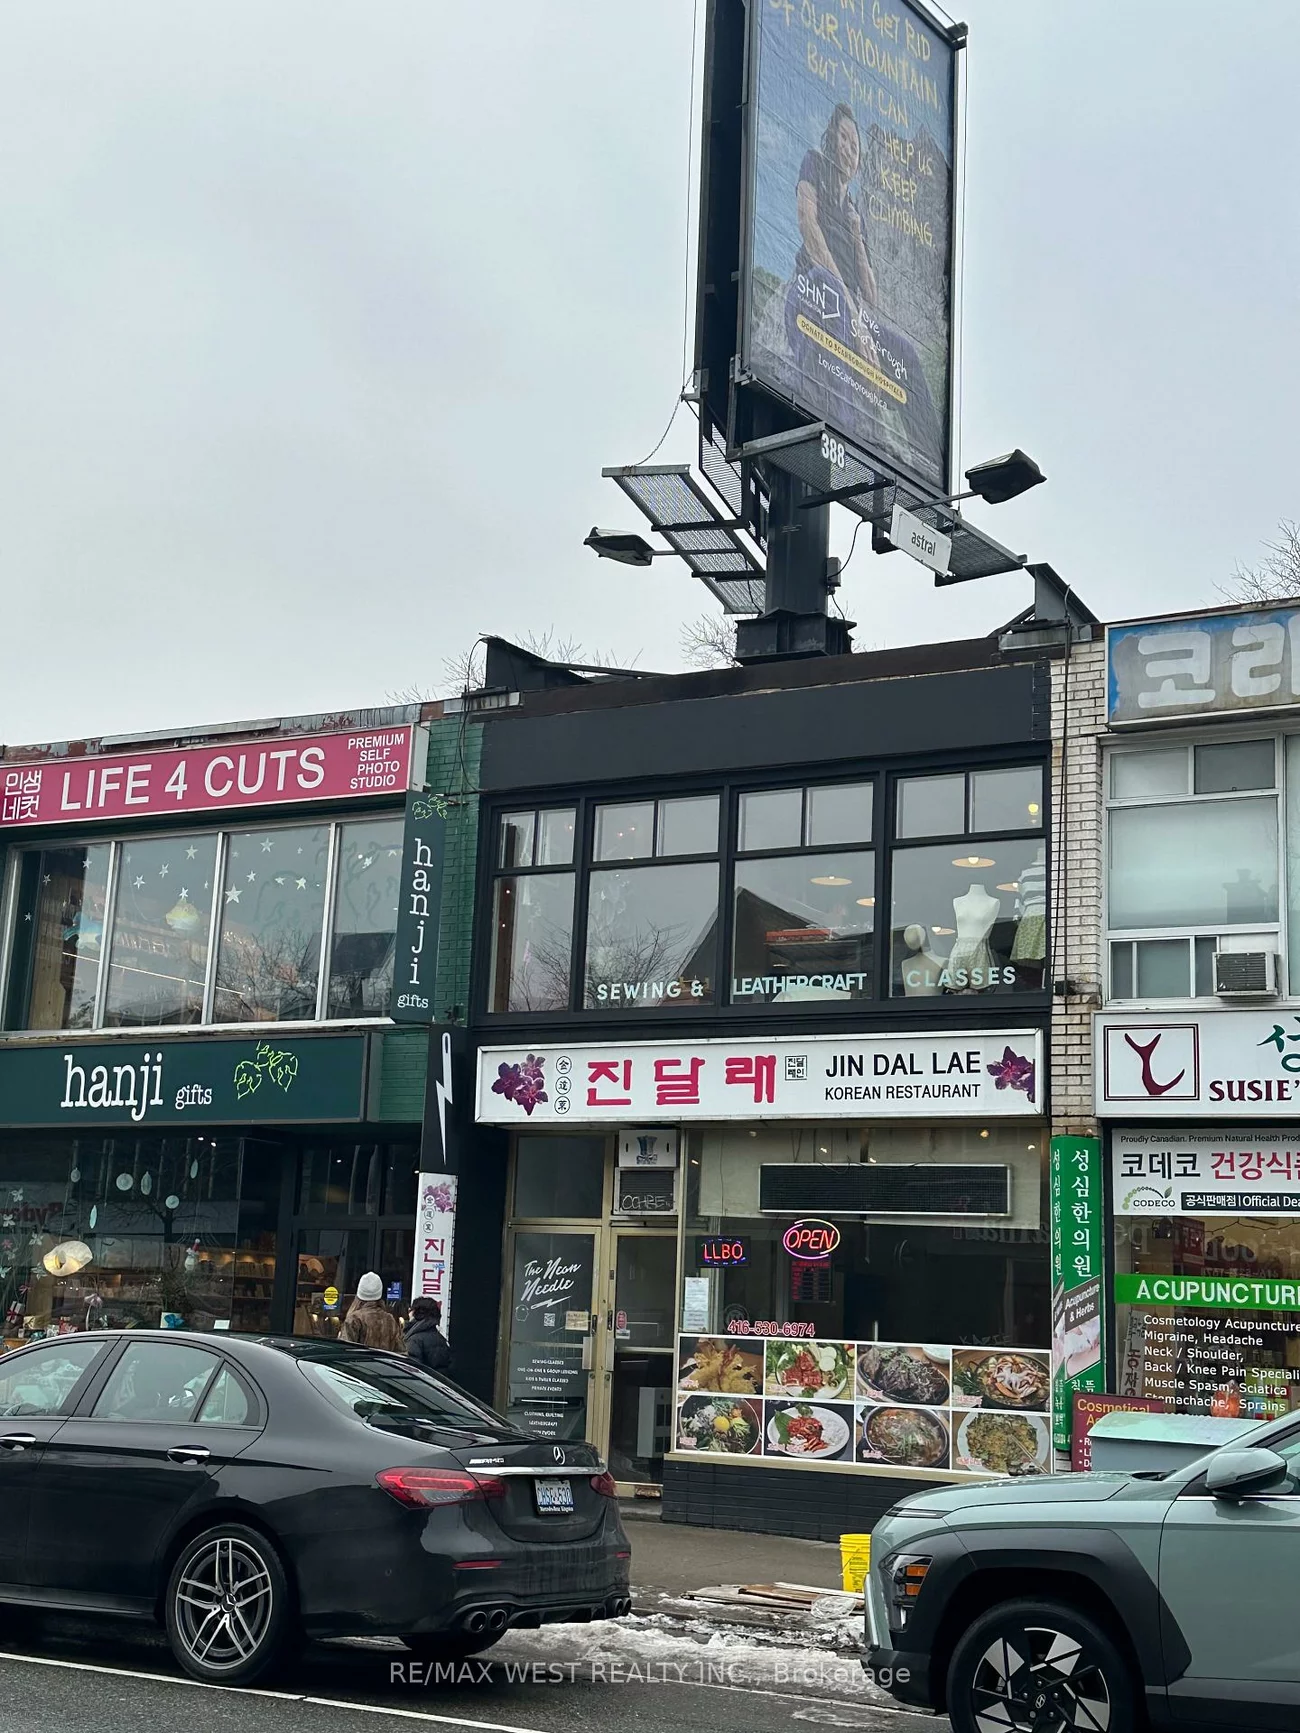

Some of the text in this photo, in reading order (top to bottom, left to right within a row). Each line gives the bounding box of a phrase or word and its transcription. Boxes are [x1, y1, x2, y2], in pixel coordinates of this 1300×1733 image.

[800, 2, 843, 49] OUR
[872, 2, 900, 44] GET
[905, 18, 931, 61] RID
[807, 42, 839, 87] BUT
[878, 87, 909, 129] CAN
[883, 126, 933, 176] HELP US
[880, 163, 917, 208] KEEP
[797, 274, 826, 309] SHN
[821, 433, 845, 468] 388
[911, 531, 937, 557] astral
[348, 733, 404, 750] PREMIUM
[357, 760, 400, 776] PHOTO
[359, 748, 391, 762] SELF
[5, 769, 42, 796] 인생
[61, 746, 326, 811] LIFE 4 CUTS
[350, 774, 396, 790] STUDIO
[2, 795, 40, 821] 네컷
[409, 837, 434, 985] hanji
[597, 966, 1017, 1001] SEWING & LEATHERCRAFT CLASSES
[397, 993, 429, 1009] gifts
[825, 1050, 981, 1078] JIN DAL LAE
[60, 1051, 213, 1121] hanji gifts
[586, 1054, 777, 1107] 진달래
[825, 1084, 981, 1101] KOREAN RESTAURANT
[1120, 1135, 1148, 1144] Proudly
[1188, 1134, 1224, 1142] Premium
[1225, 1134, 1253, 1142] Natural
[1254, 1134, 1280, 1142] Health
[1120, 1152, 1201, 1180] 코데코
[1071, 1149, 1093, 1277] 성심한의원
[1133, 1199, 1176, 1208] CODECO
[1242, 1195, 1281, 1208] Official
[704, 1243, 743, 1260] LLBO
[787, 1229, 835, 1249] OPEN
[422, 1238, 445, 1313] 진달
[1136, 1279, 1300, 1306] ACUPUNCTUR
[1076, 1302, 1095, 1319] Herbs
[1143, 1314, 1221, 1330] Cosmetology
[1225, 1318, 1300, 1332] Acupuncture
[727, 1320, 816, 1337] 416-530-6974
[1144, 1331, 1263, 1346] Migraine, Headache
[1144, 1346, 1173, 1357] Neck
[1187, 1348, 1244, 1362] Shoulder,
[1144, 1362, 1173, 1373] Back
[1186, 1364, 1217, 1375] Knee
[1221, 1365, 1247, 1377] Pain
[1144, 1377, 1288, 1396] Muscle Spasm, Sciatica
[1239, 1399, 1286, 1412] Sprains
